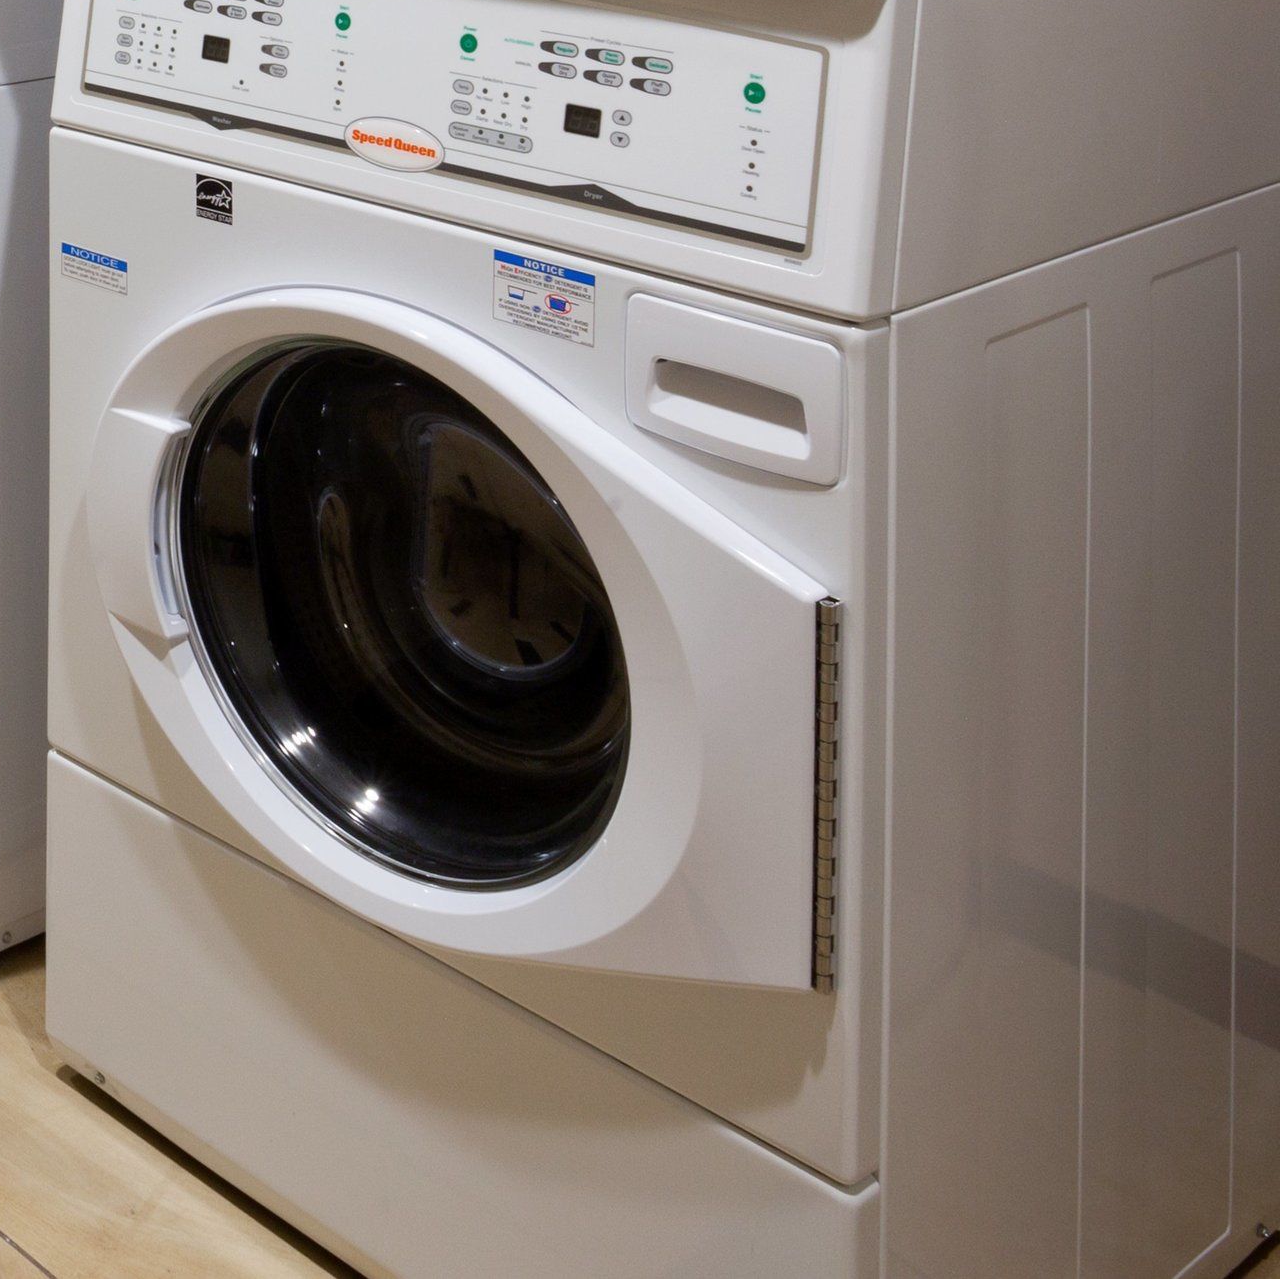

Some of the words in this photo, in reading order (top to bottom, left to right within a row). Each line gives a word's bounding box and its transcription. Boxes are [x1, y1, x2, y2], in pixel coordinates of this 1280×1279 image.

[351, 129, 393, 148] Speed
[393, 138, 436, 158] Queen
[583, 189, 604, 202] Dryer
[70, 246, 119, 269] NOTICE
[523, 259, 565, 277] NOTICE
